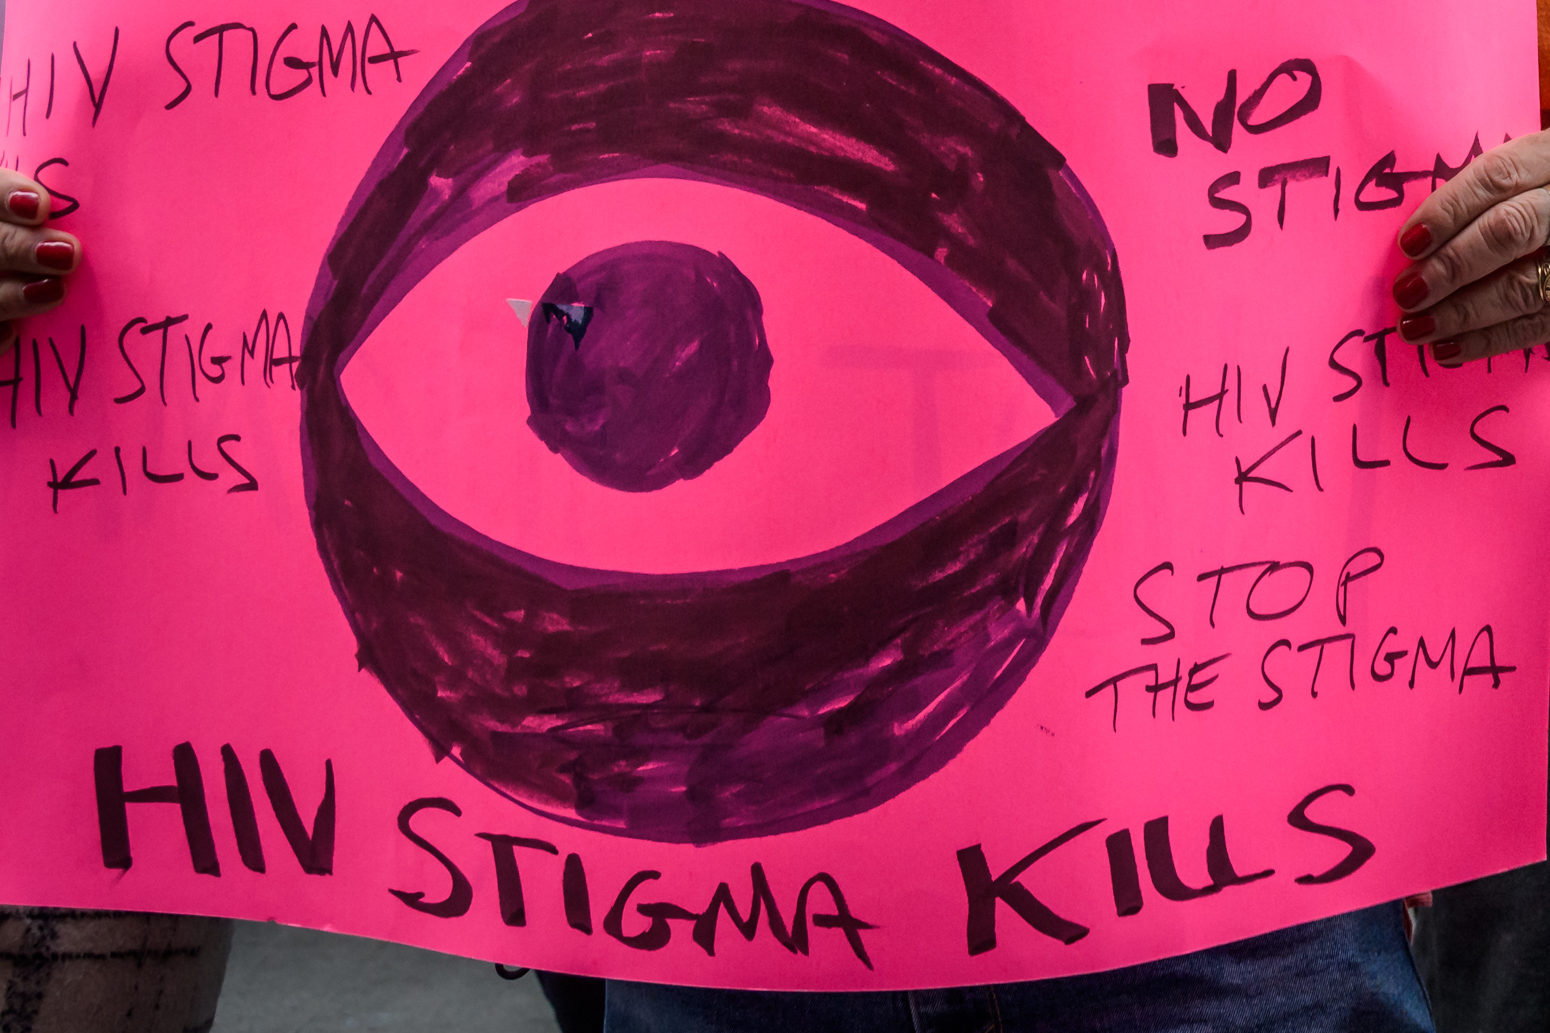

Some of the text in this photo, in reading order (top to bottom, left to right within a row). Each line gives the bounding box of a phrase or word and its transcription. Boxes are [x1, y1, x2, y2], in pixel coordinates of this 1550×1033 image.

[6, 14, 418, 139] HIV STIGMA
[1147, 58, 1323, 156] NO
[1202, 131, 1513, 251] STIGM
[113, 308, 300, 408] STIGMA
[1178, 346, 1290, 439] HIV
[47, 433, 259, 515] KILLS
[1234, 405, 1517, 515] KILLS
[1133, 547, 1385, 647] STOP
[1084, 624, 1517, 733] THE STIGMA
[93, 740, 1378, 971] HIV STIGMA KILLS
